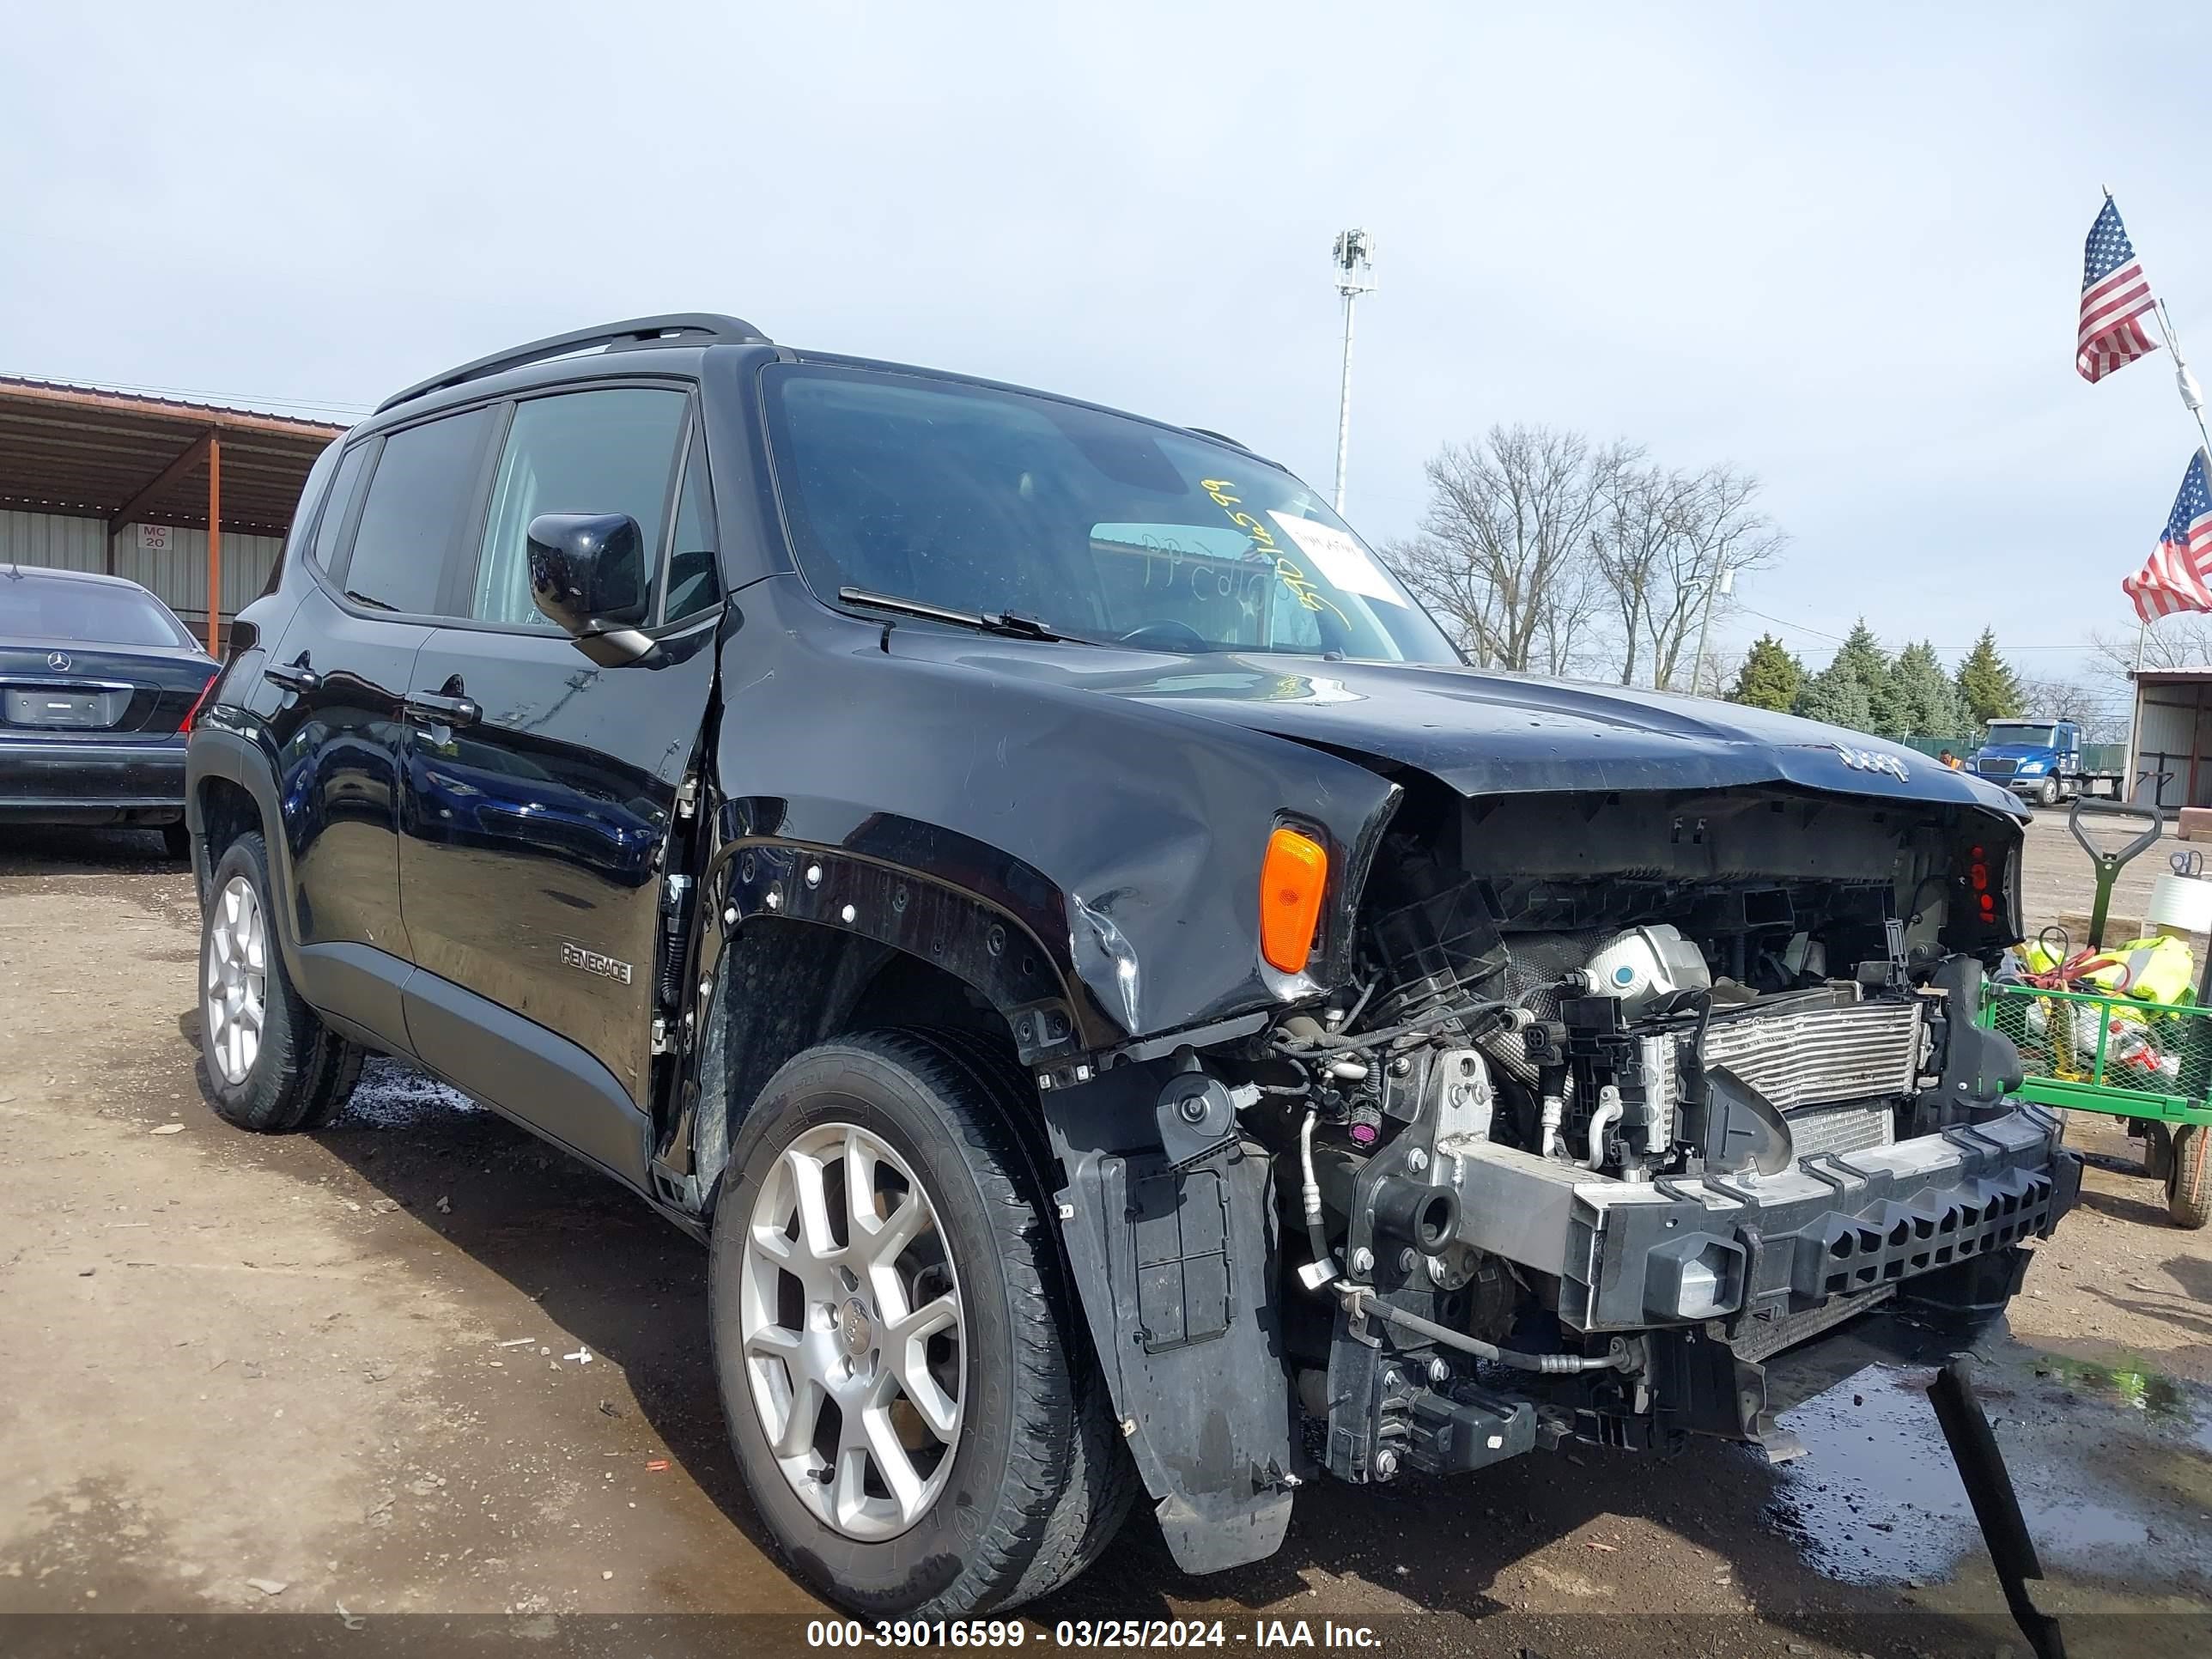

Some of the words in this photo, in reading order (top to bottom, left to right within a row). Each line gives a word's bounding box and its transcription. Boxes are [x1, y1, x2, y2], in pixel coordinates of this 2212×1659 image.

[143, 526, 167, 537] MC
[146, 538, 165, 548] 20
[1831, 740, 1911, 784] Jeep
[560, 941, 634, 985] RENEGADE
